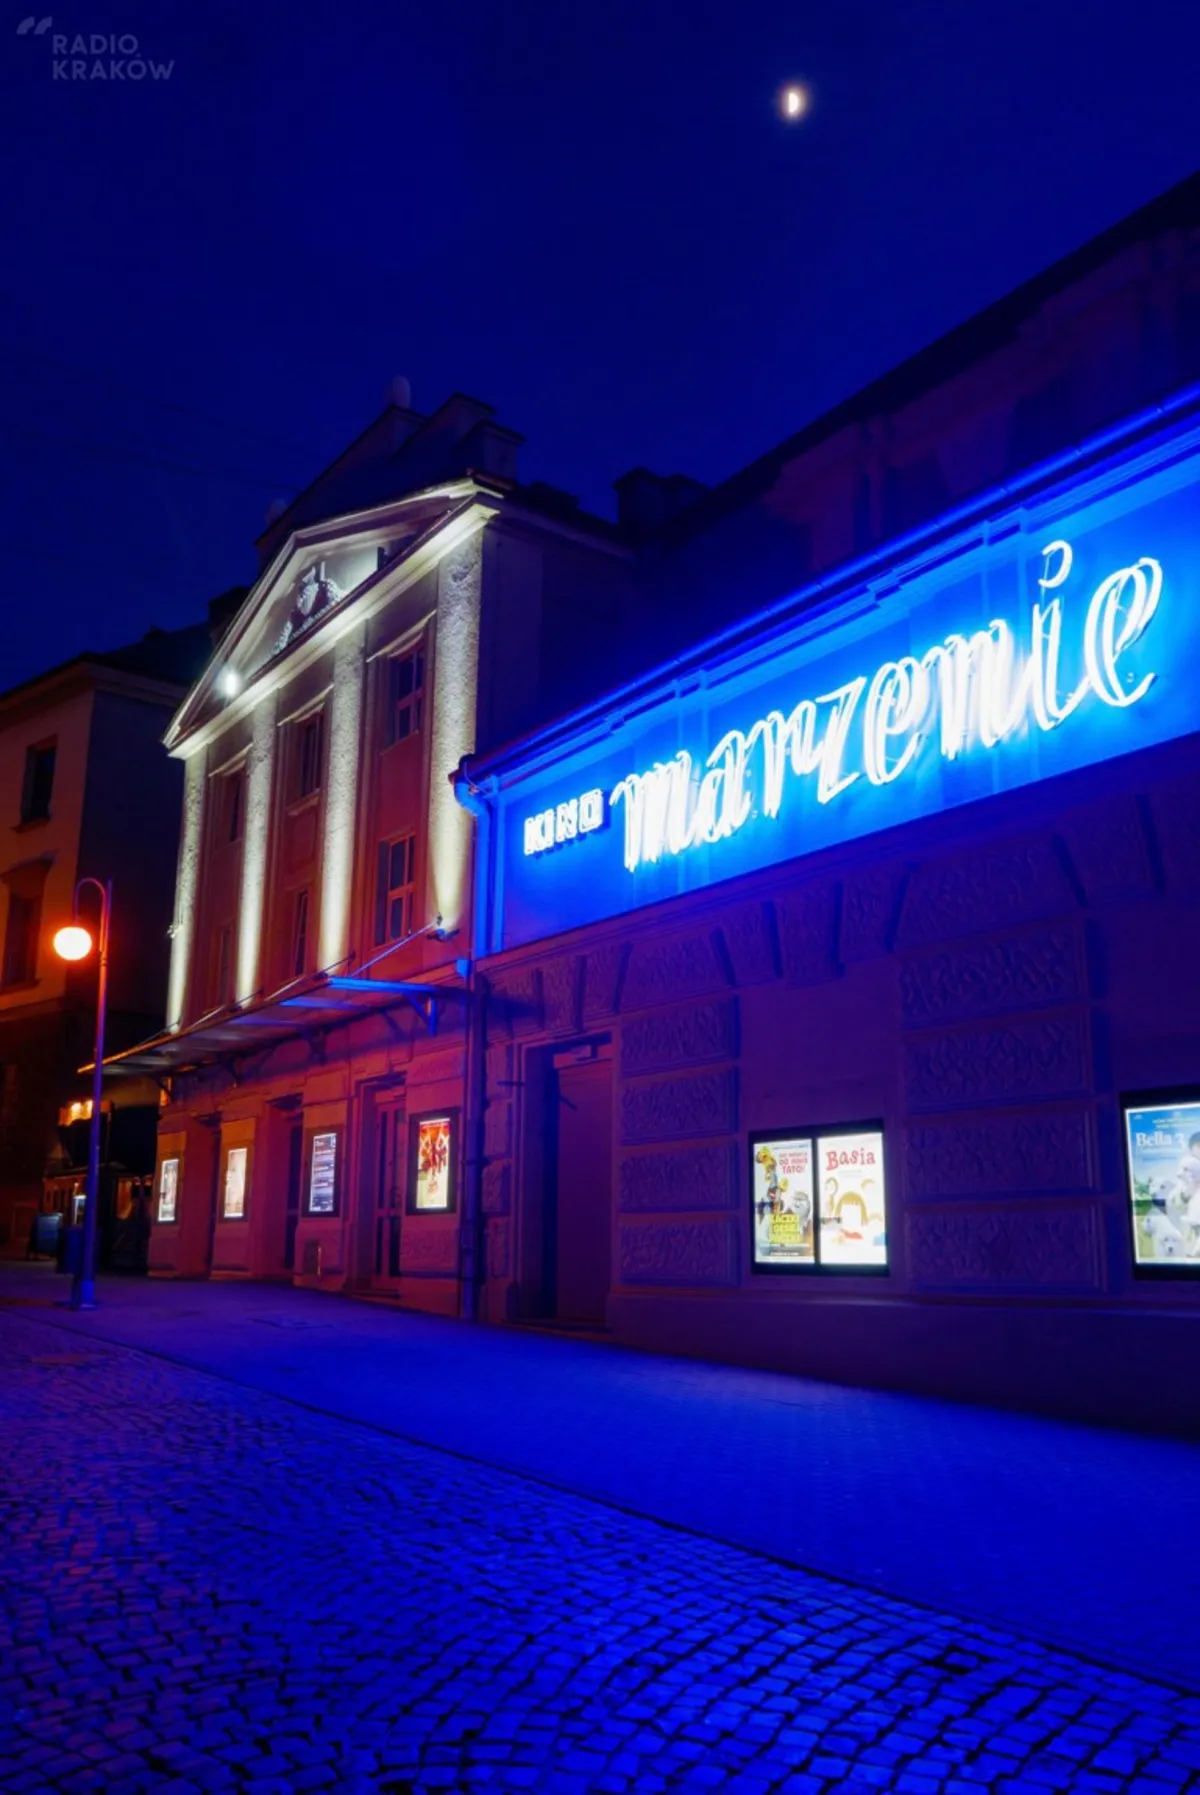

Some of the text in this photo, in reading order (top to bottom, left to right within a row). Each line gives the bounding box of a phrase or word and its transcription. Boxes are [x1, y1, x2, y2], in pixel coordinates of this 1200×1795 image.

[523, 540, 1164, 873] KINO marzenie
[1136, 1131, 1172, 1146] Bella
[826, 1147, 876, 1171] Basia
